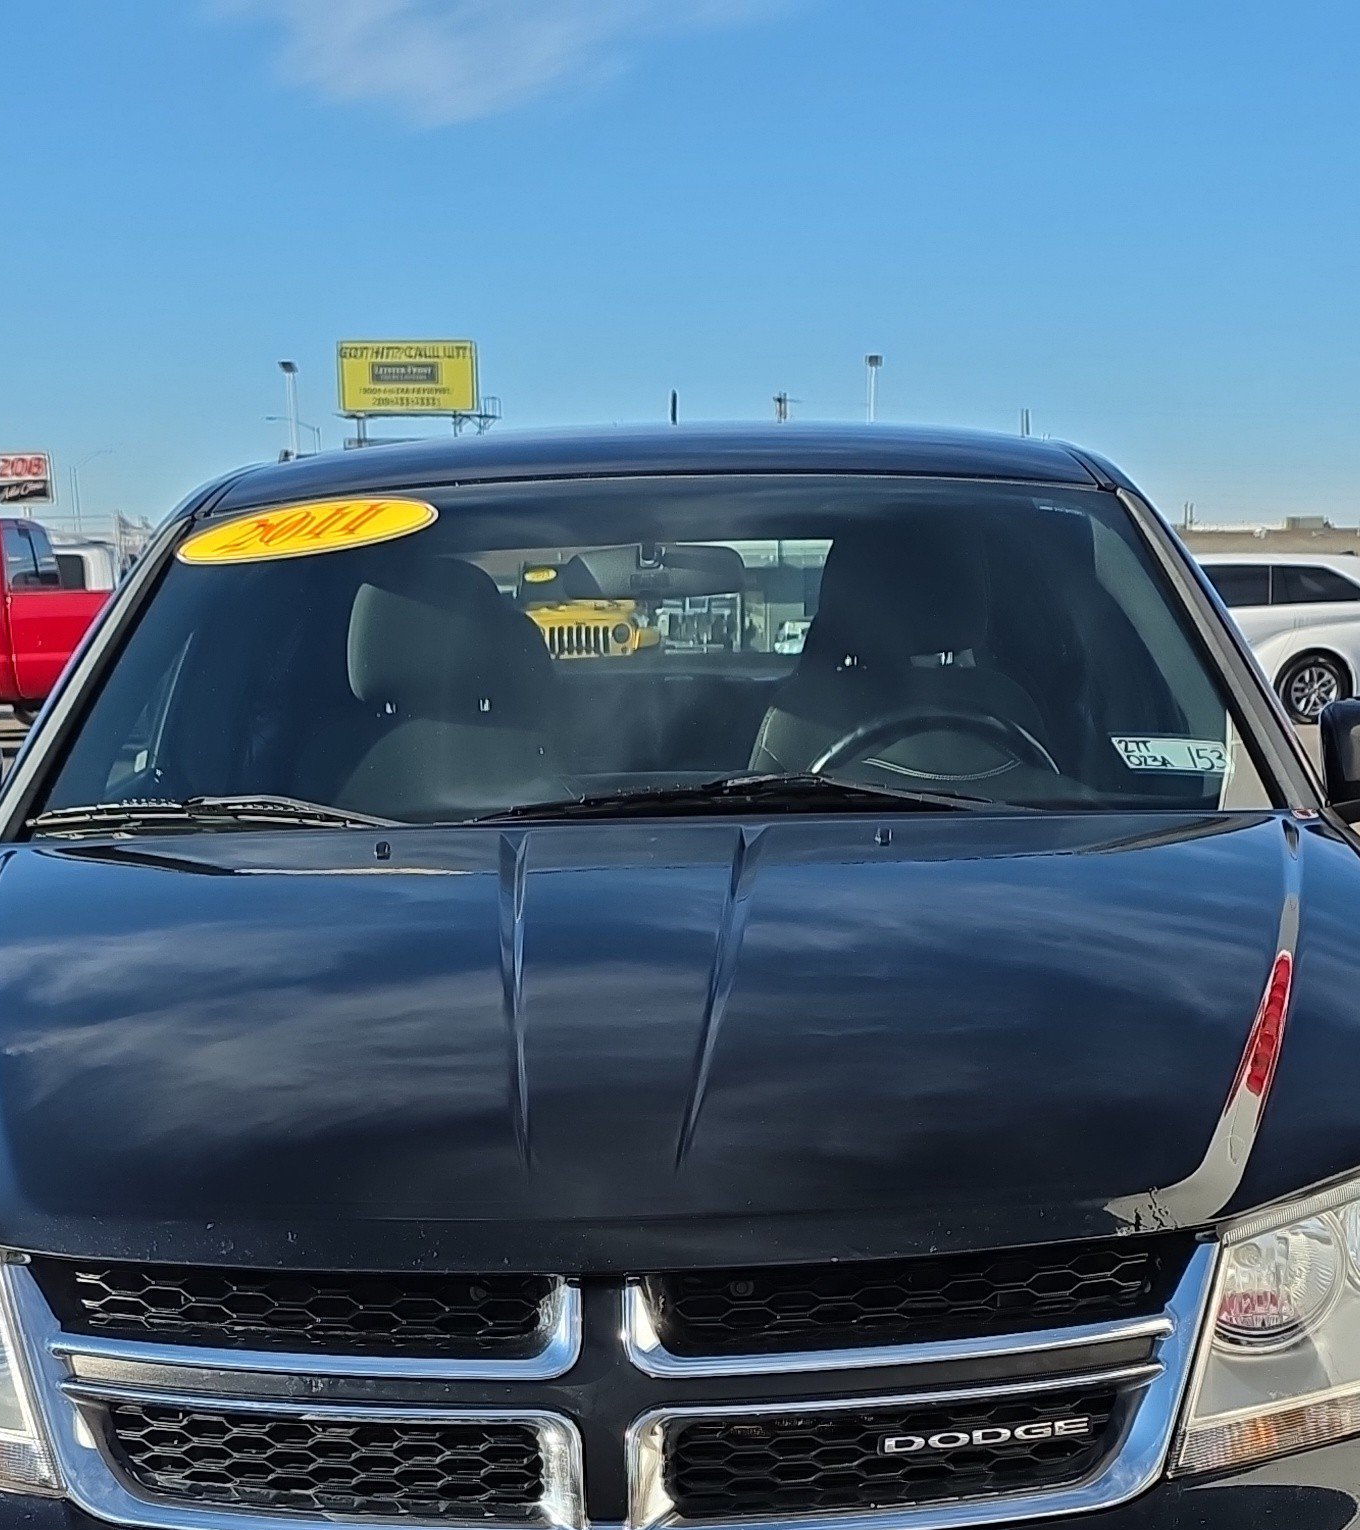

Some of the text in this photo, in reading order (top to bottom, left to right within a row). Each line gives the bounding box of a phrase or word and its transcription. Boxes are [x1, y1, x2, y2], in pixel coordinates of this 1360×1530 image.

[213, 502, 387, 555] 2011
[1186, 746, 1228, 771] 153
[884, 1416, 1091, 1453] DODGE
